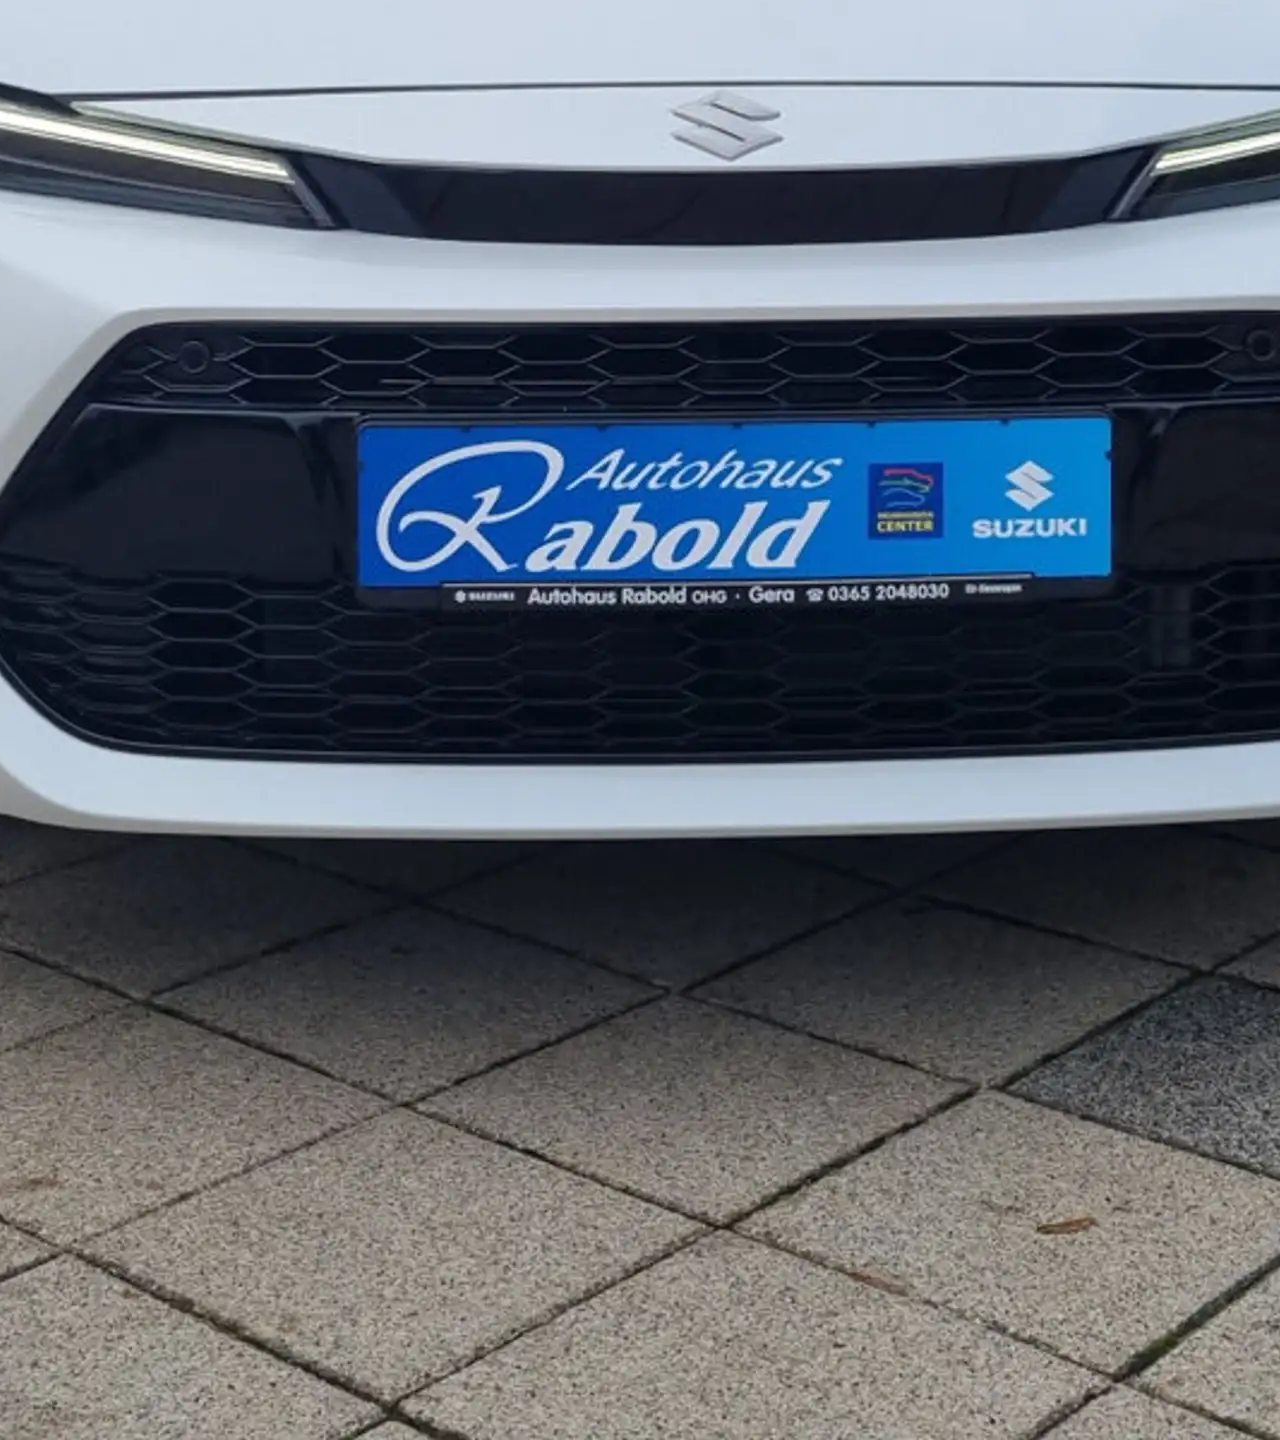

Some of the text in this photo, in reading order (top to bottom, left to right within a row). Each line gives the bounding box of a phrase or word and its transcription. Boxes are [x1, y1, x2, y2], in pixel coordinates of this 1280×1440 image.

[565, 447, 844, 492] Autohaus
[376, 440, 830, 572] Rabold
[876, 519, 933, 533] CENTER
[972, 517, 1088, 539] SUZUKI
[527, 587, 618, 606] Autohaus
[621, 586, 687, 605] Rabold
[691, 589, 728, 604] OHG
[748, 584, 796, 603] Gera
[827, 584, 871, 602] 0365
[875, 582, 950, 600] 2048030
